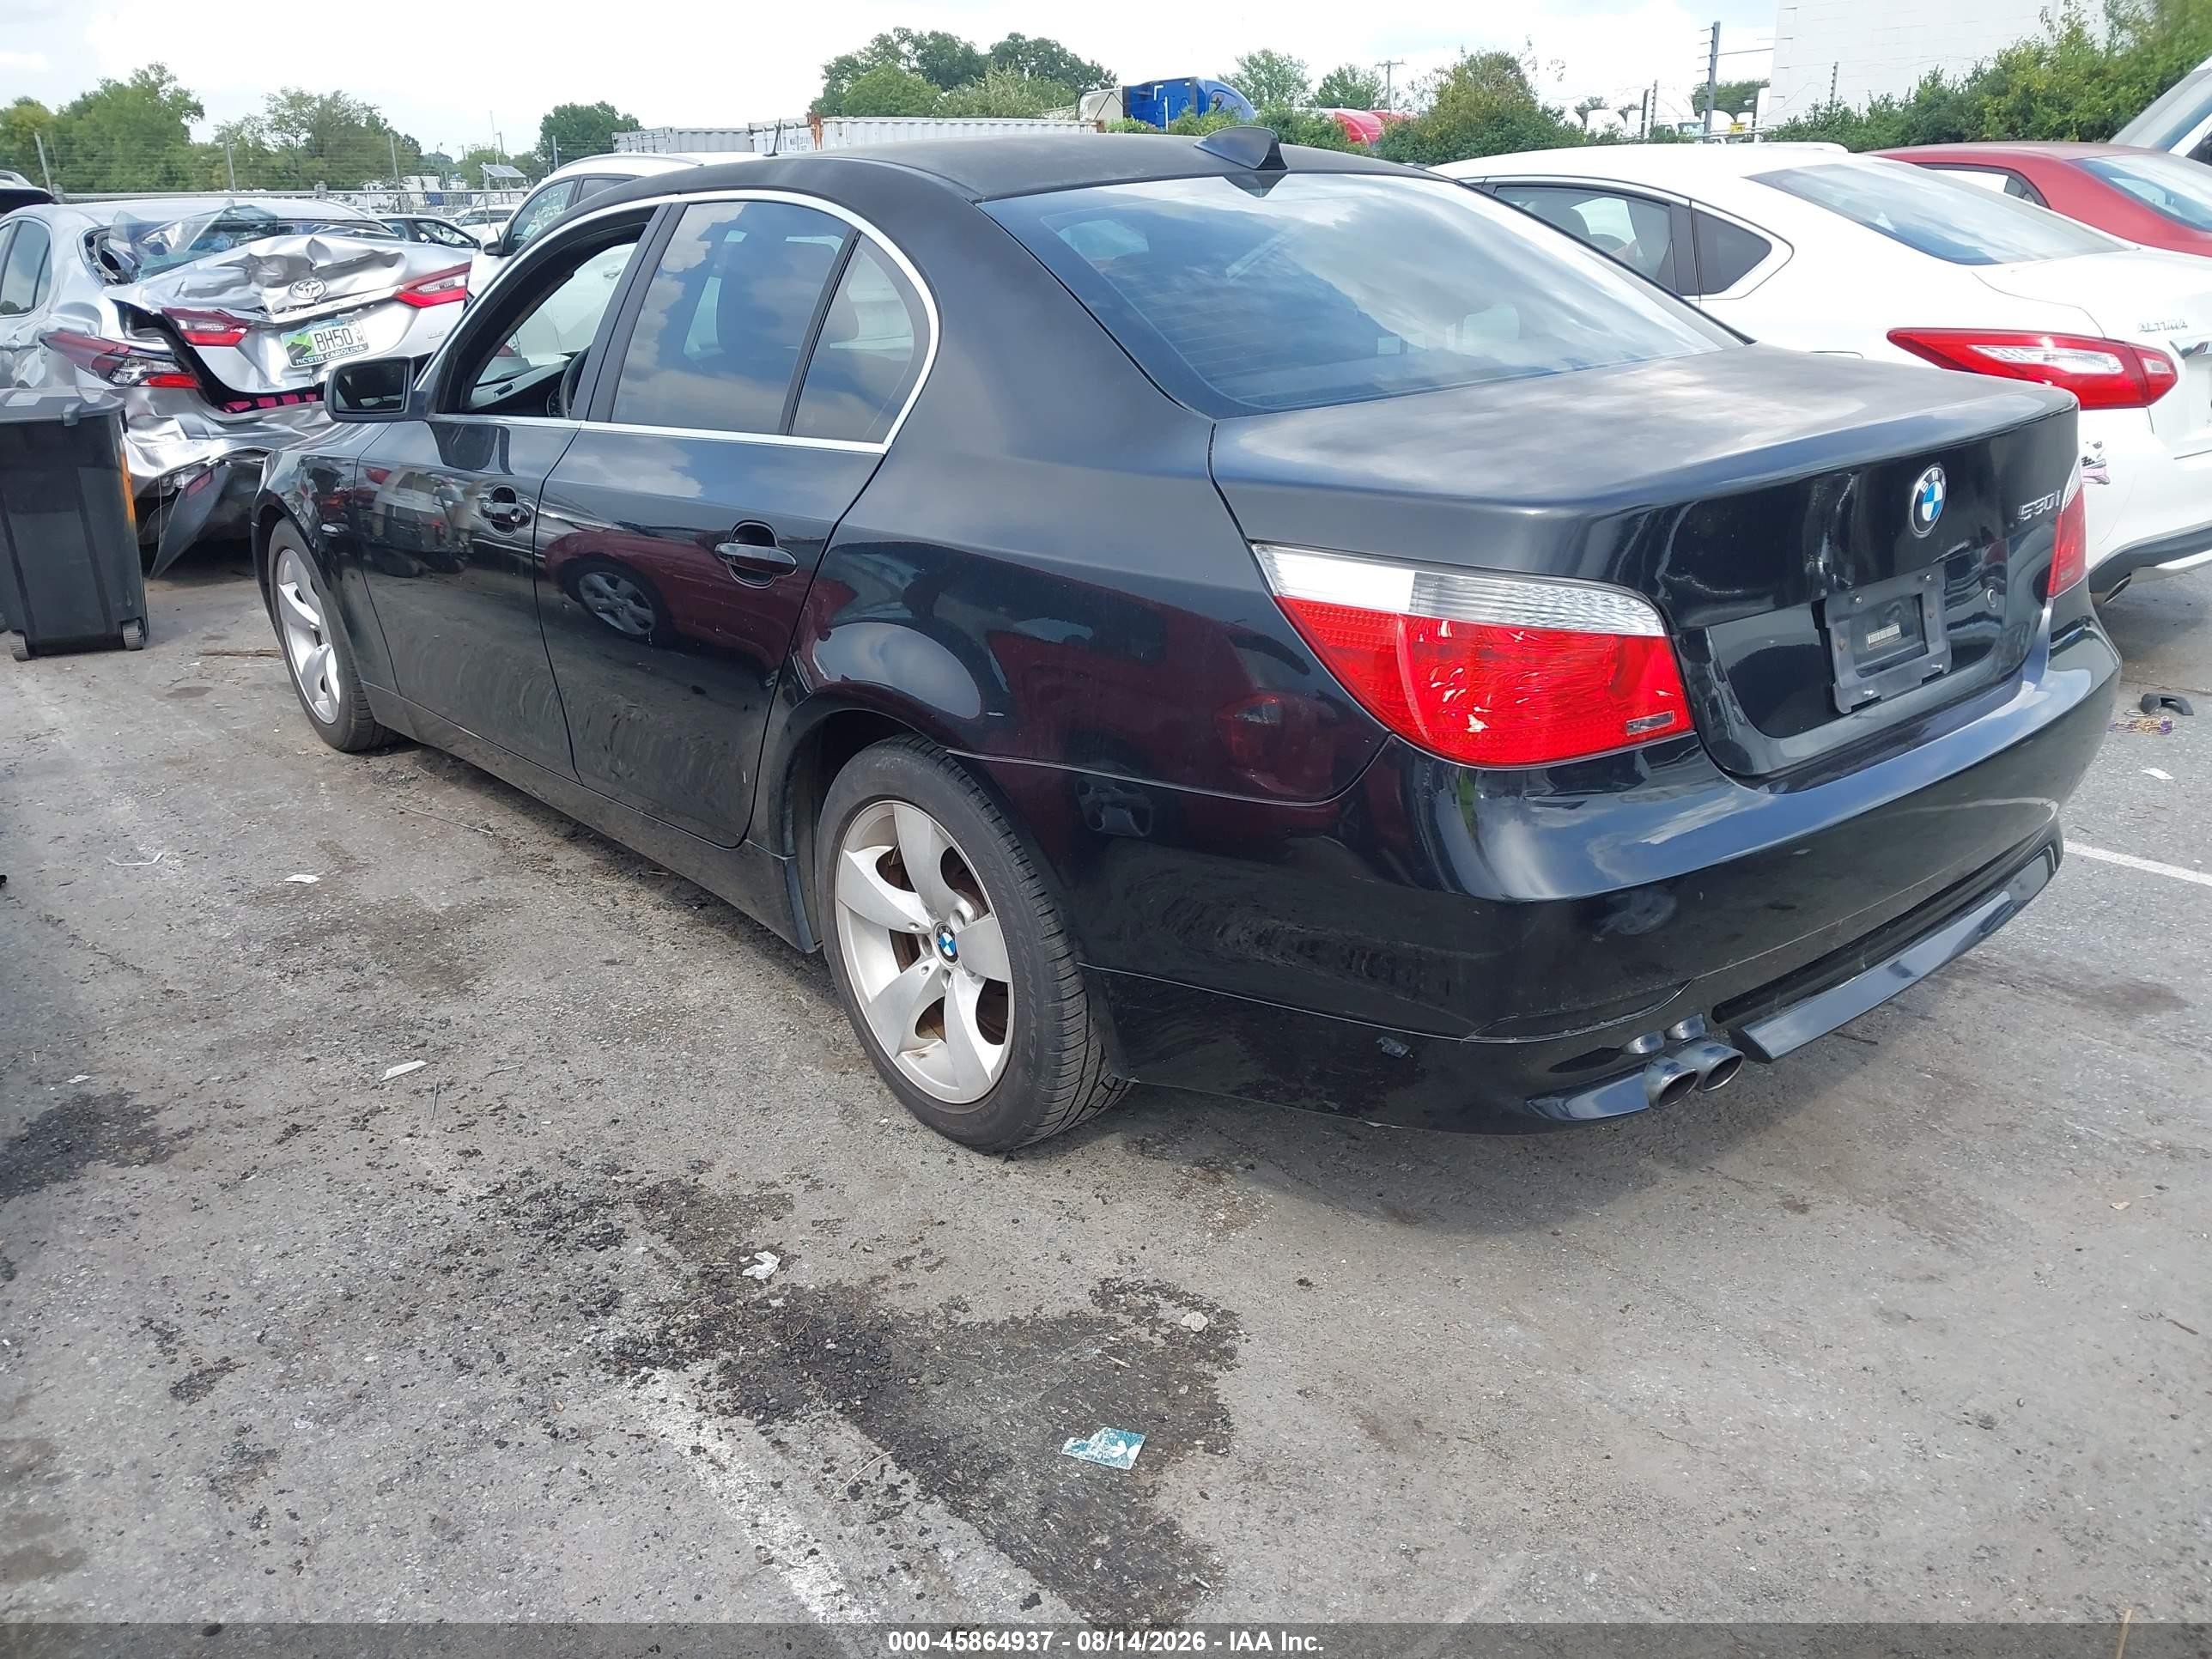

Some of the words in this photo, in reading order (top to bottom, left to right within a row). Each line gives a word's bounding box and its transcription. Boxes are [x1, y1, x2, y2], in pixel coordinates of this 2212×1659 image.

[314, 328, 353, 352] BH50
[295, 354, 325, 366] NORTH
[326, 345, 364, 360] CAROLINA
